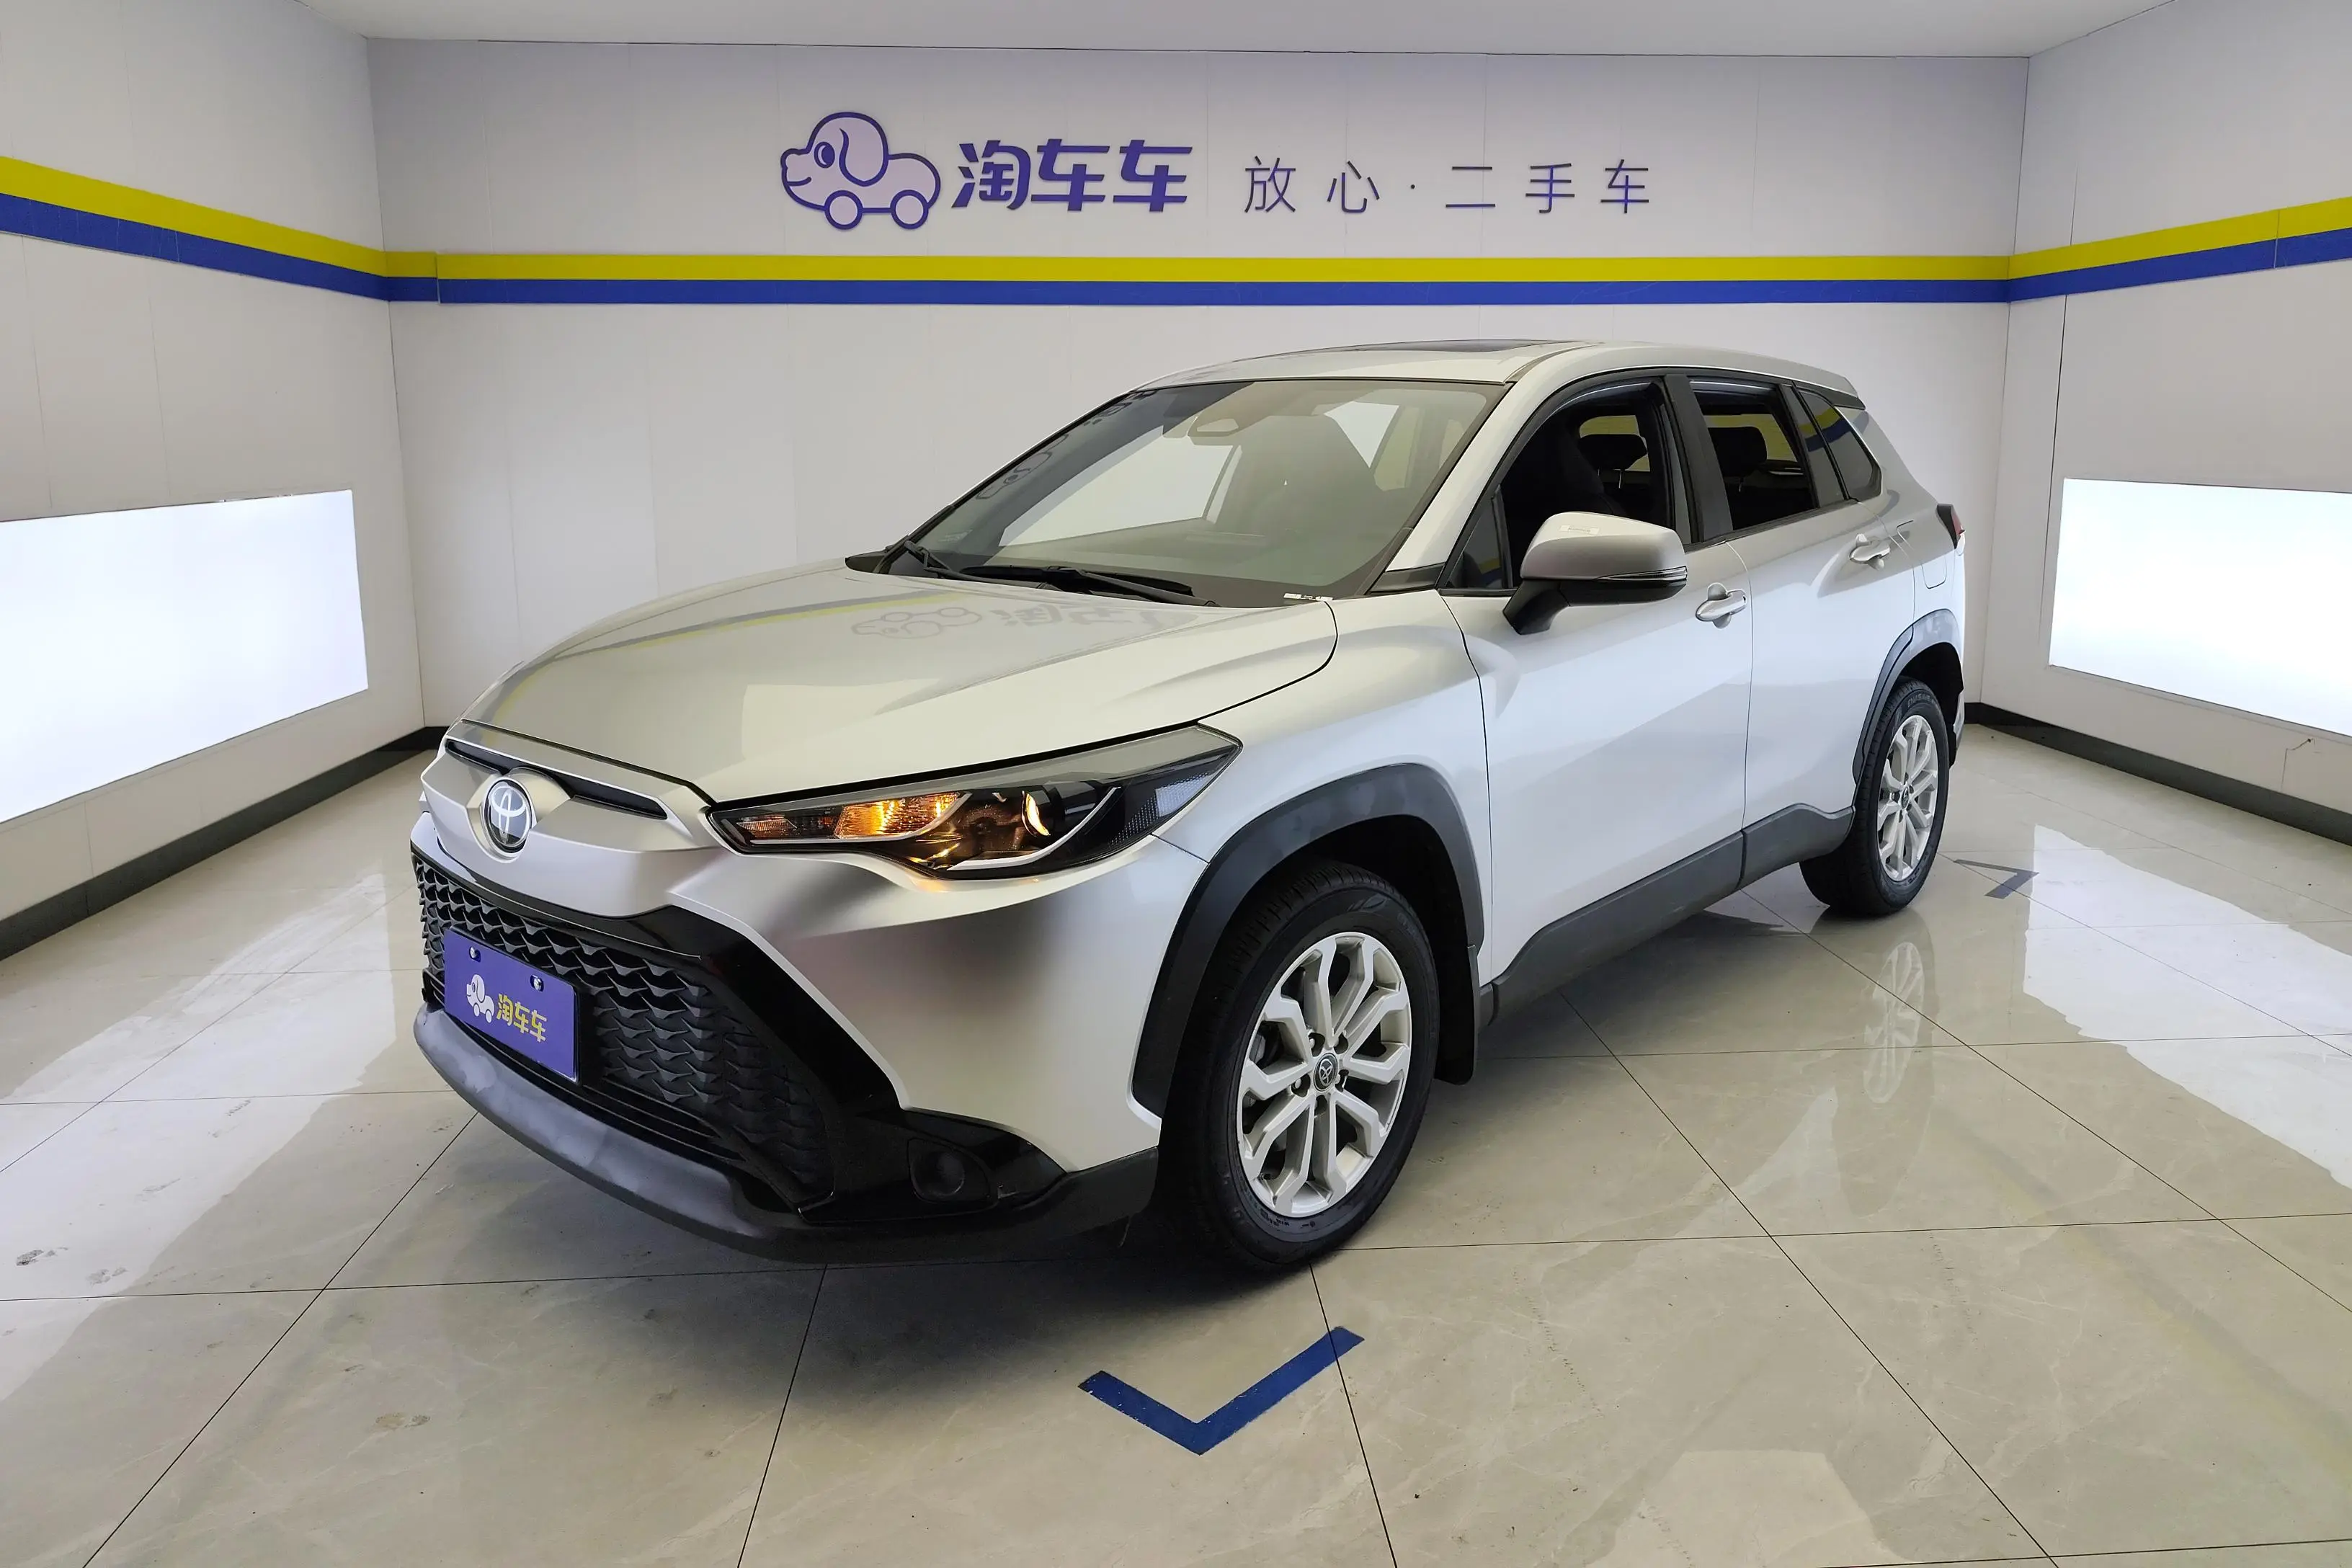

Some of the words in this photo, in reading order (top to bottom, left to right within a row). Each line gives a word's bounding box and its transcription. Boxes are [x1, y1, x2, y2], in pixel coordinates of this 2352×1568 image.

[950, 138, 1193, 213] 淘车车
[496, 993, 547, 1042] 淘车车
